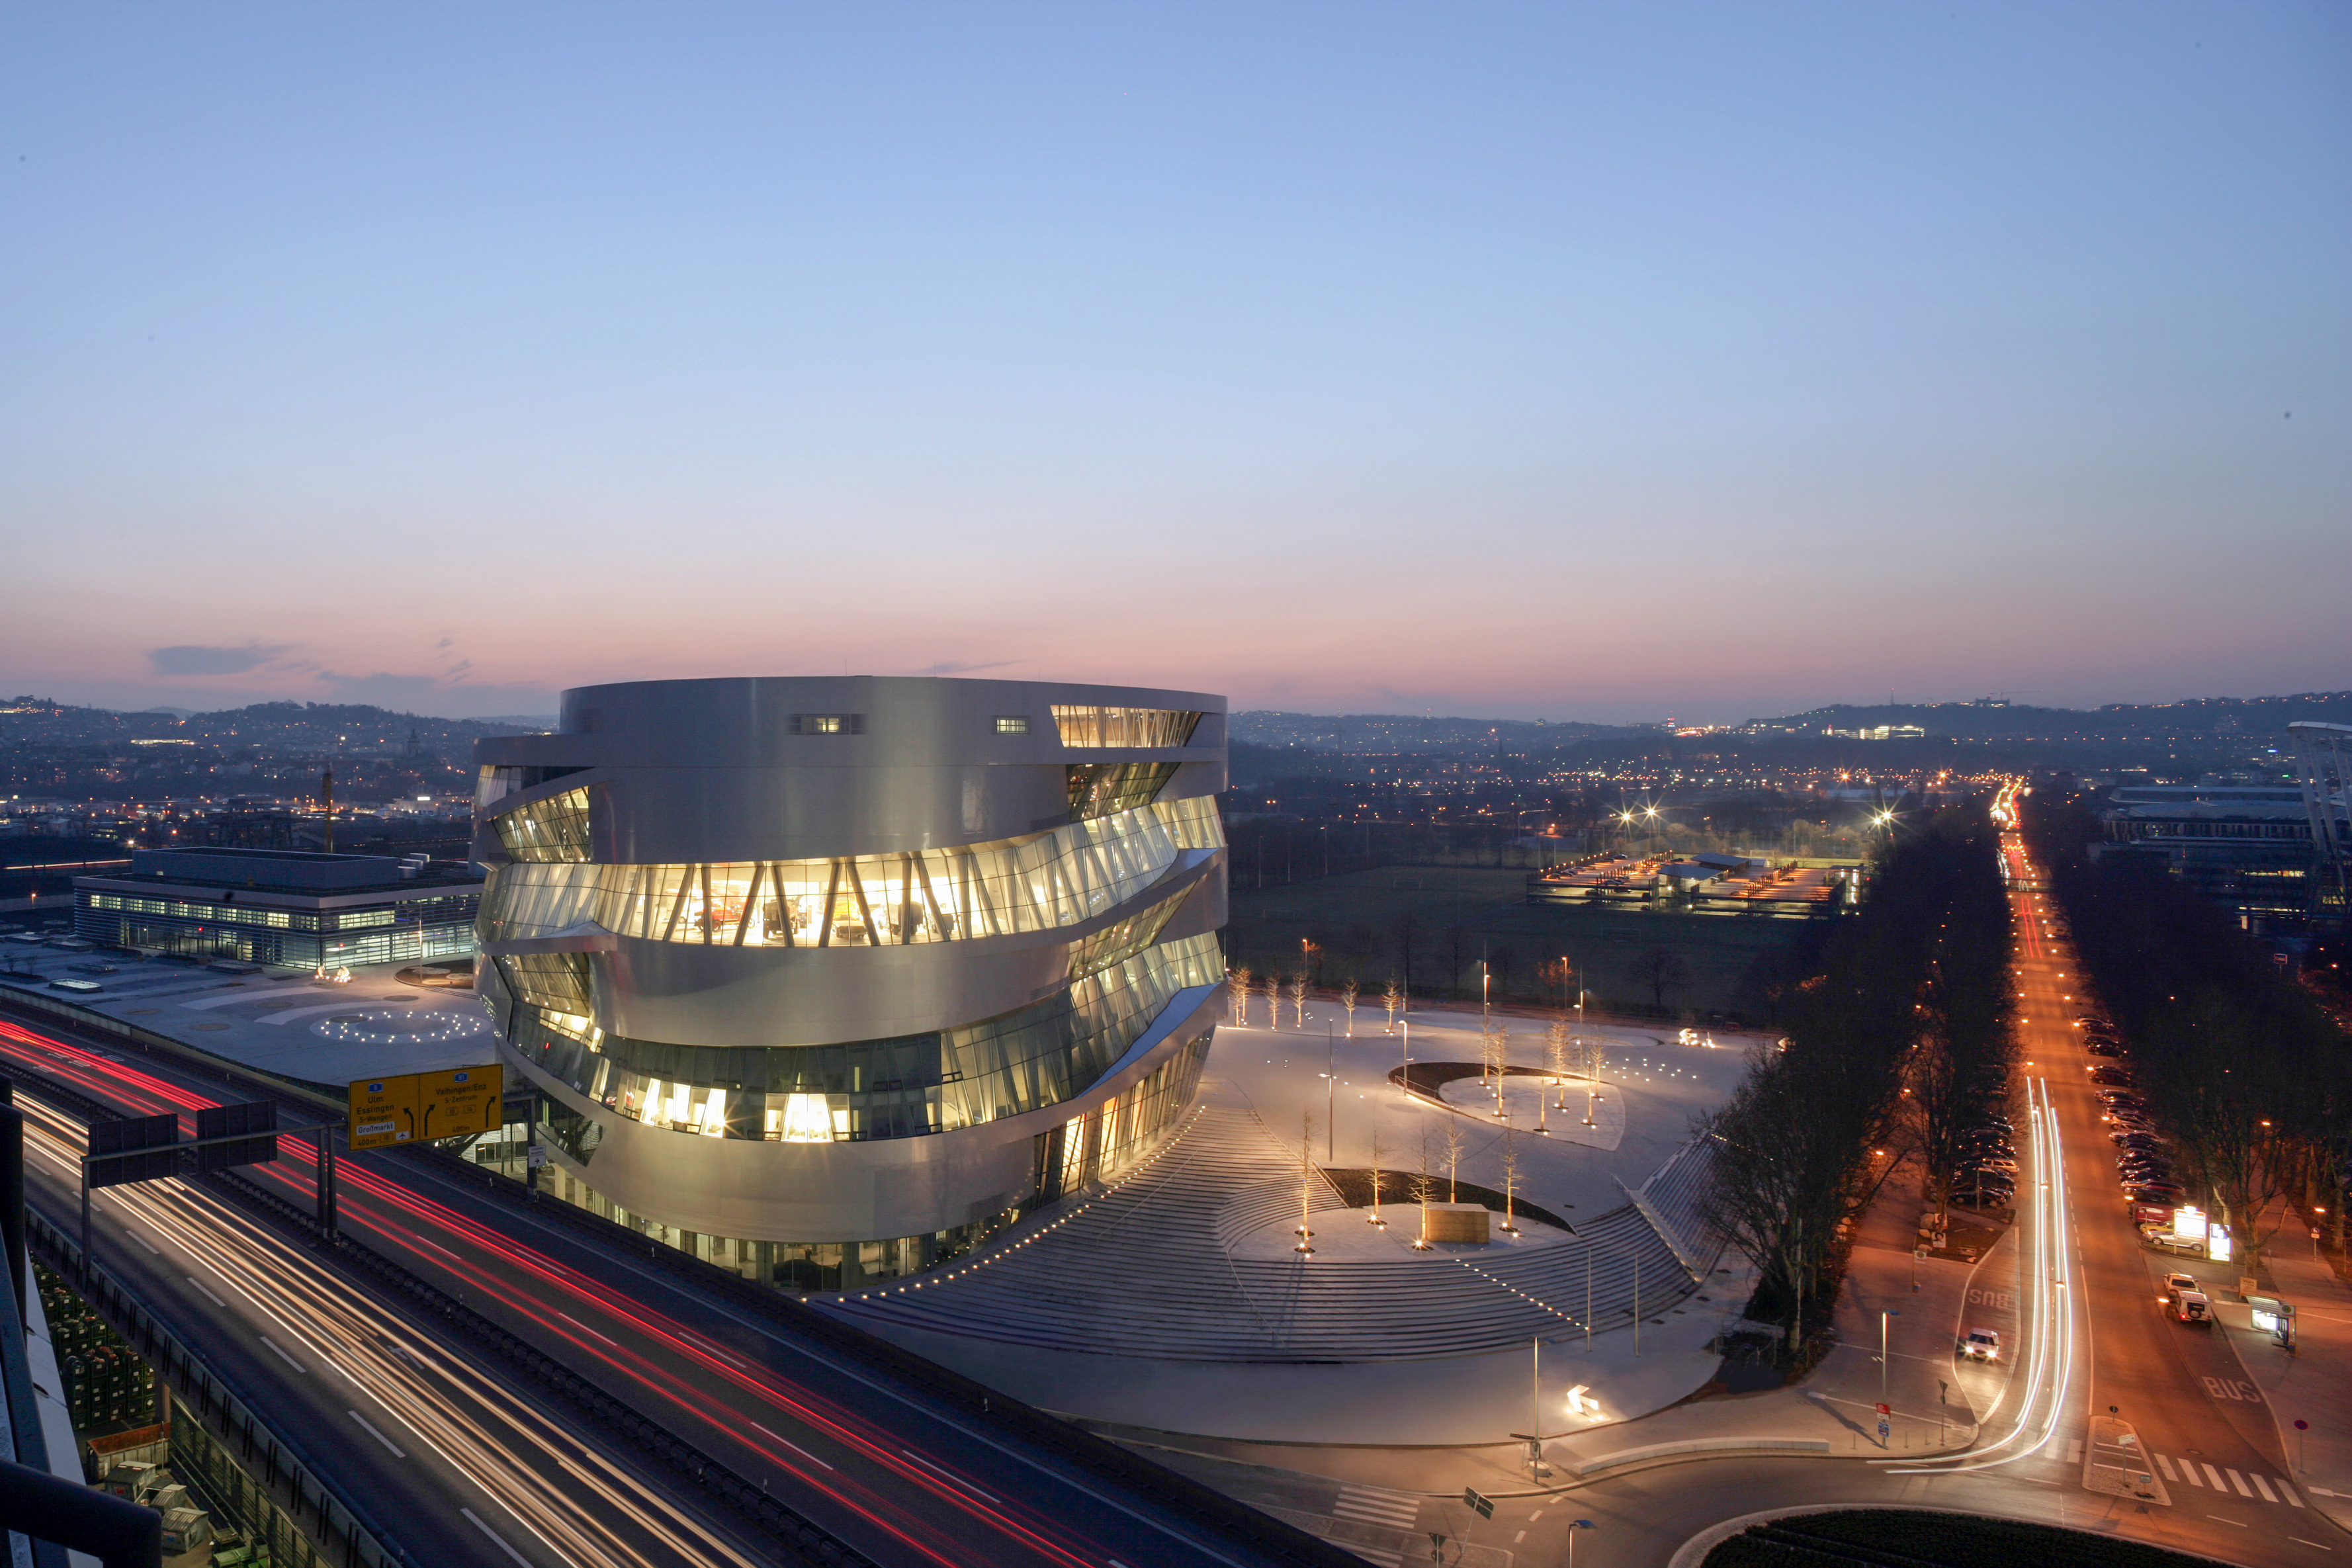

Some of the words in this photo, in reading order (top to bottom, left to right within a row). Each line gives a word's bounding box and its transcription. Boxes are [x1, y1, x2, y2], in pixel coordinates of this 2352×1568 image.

[435, 1084, 487, 1095] Vaihingen/Enz
[445, 1095, 478, 1104] S-Zentrum
[357, 1104, 394, 1115] Esslingen
[359, 1114, 392, 1123] S-Wangen
[358, 1123, 393, 1133] Großmarkt
[1968, 1289, 2011, 1309] BUS
[2201, 1376, 2261, 1403] BUS
